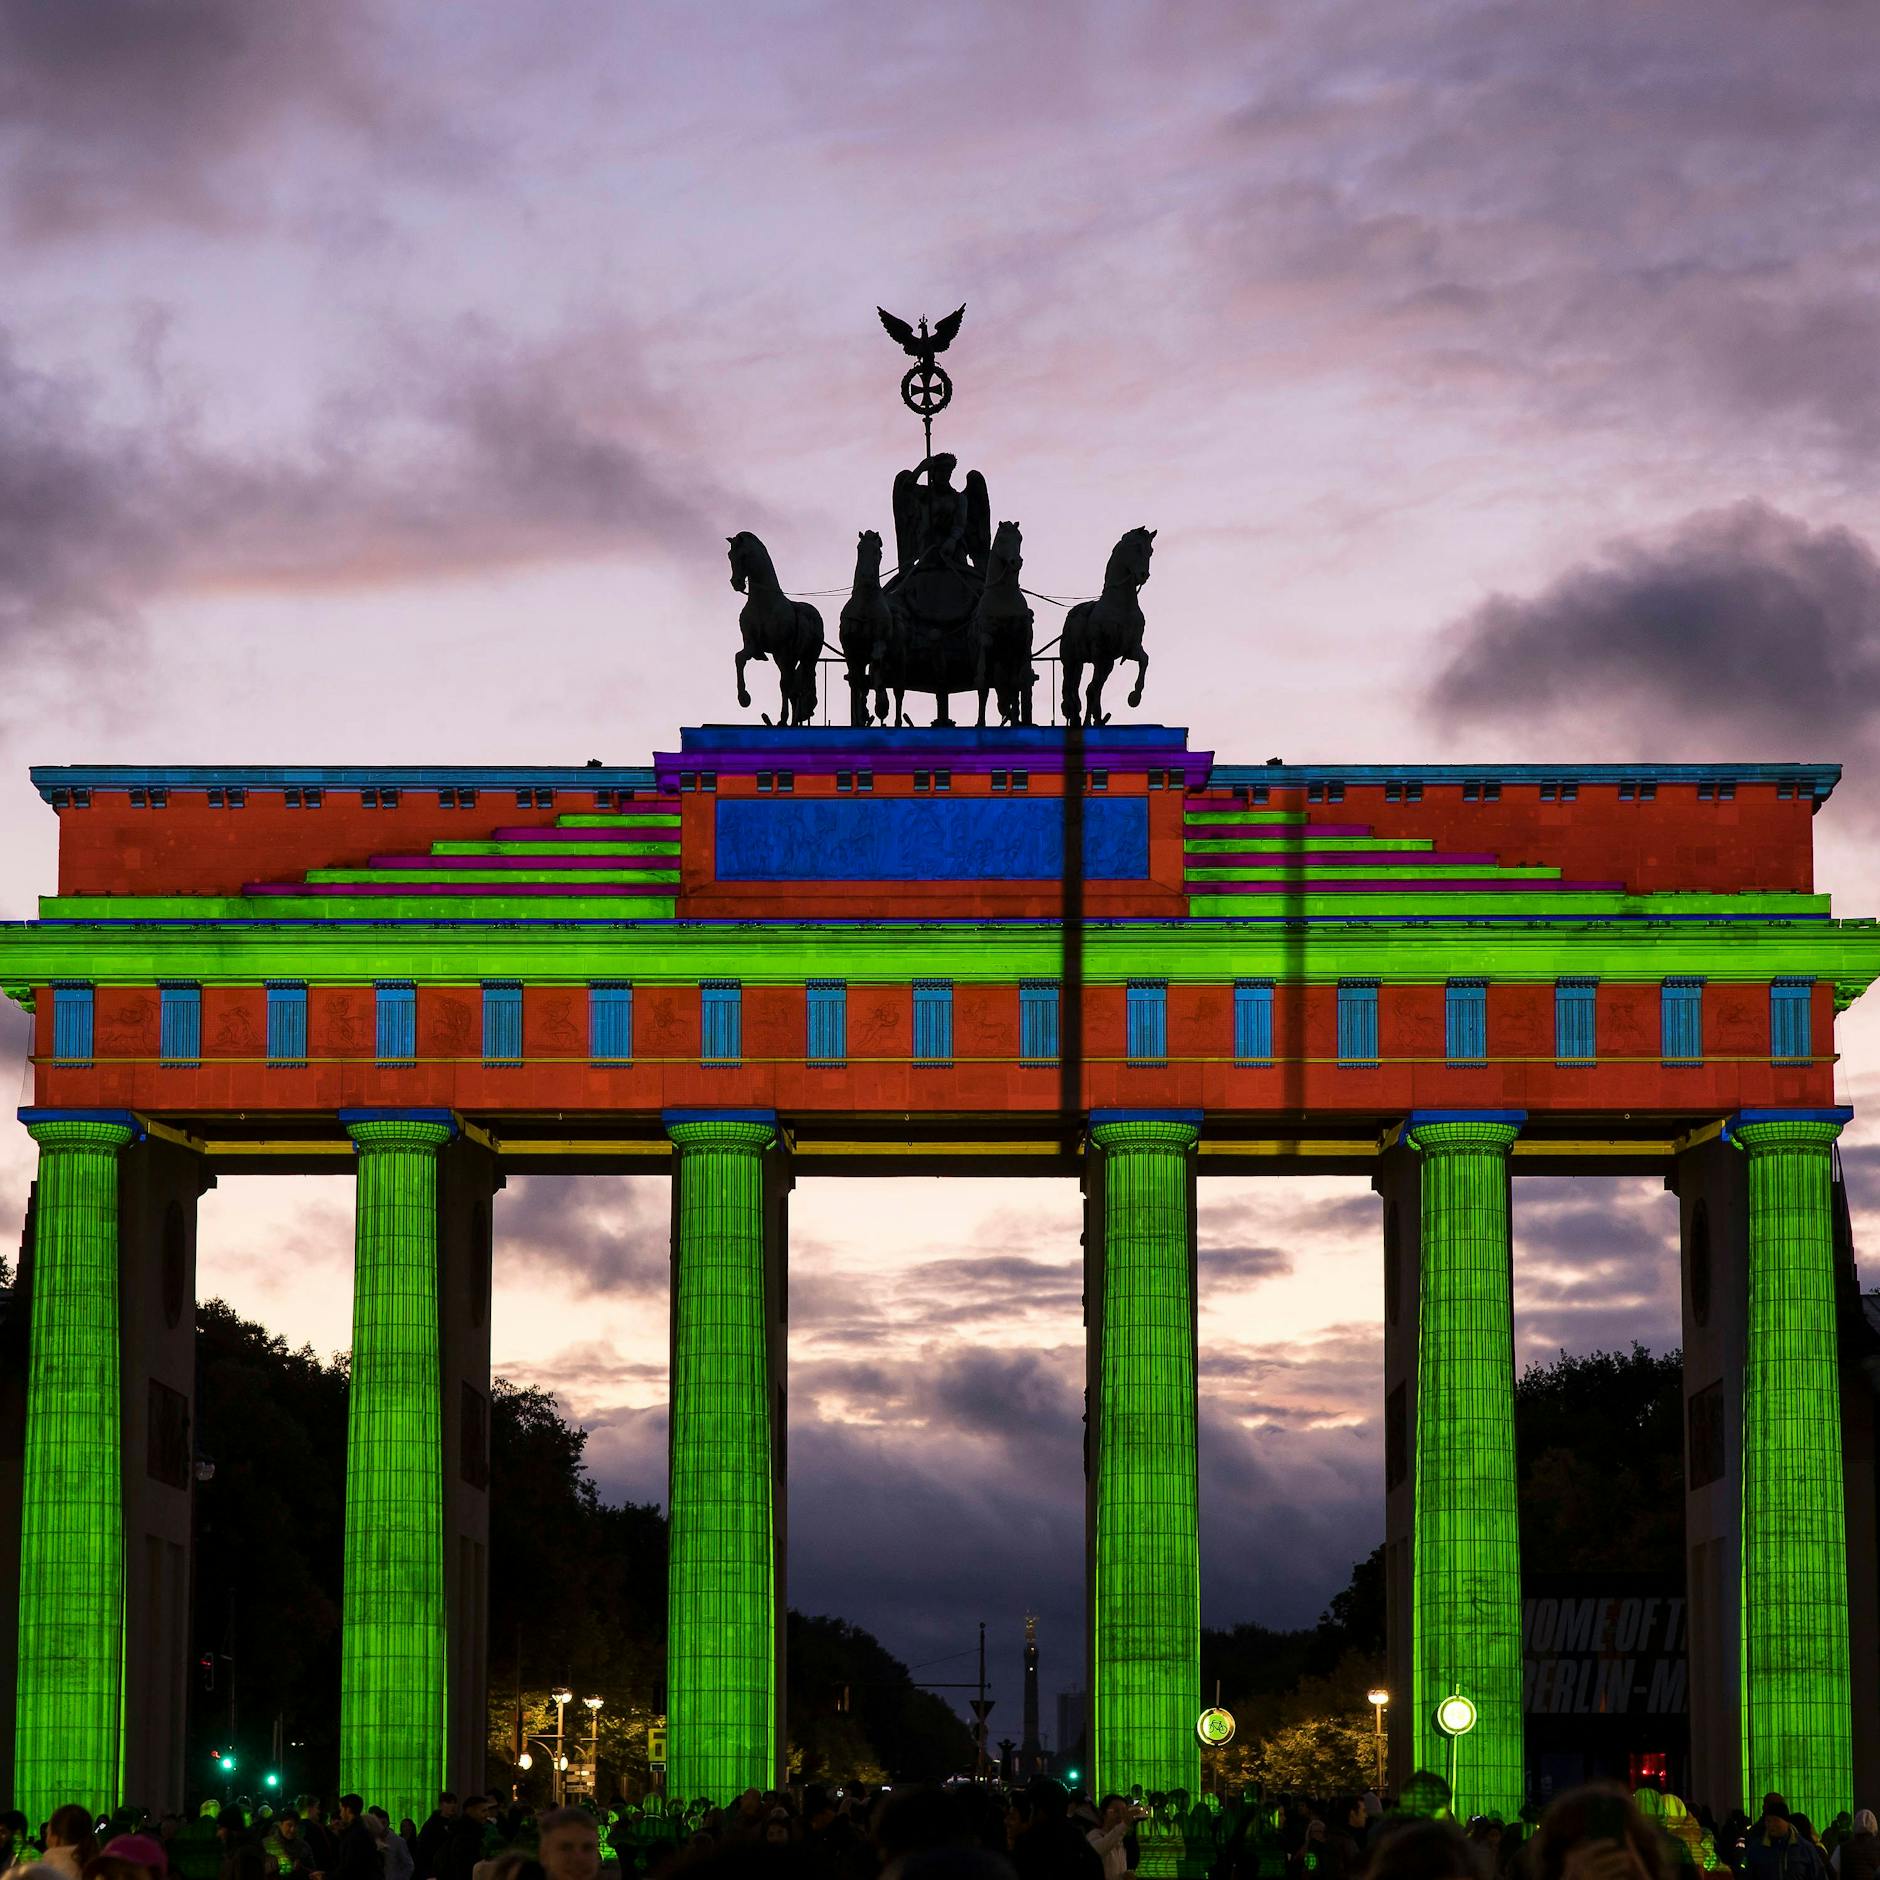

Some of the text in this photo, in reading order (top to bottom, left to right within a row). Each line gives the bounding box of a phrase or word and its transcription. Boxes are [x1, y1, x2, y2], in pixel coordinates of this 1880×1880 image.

[1615, 1597, 1660, 1652] OF
[1664, 1597, 1687, 1652] T
[1524, 1658, 1687, 1713] ERLIN-M
